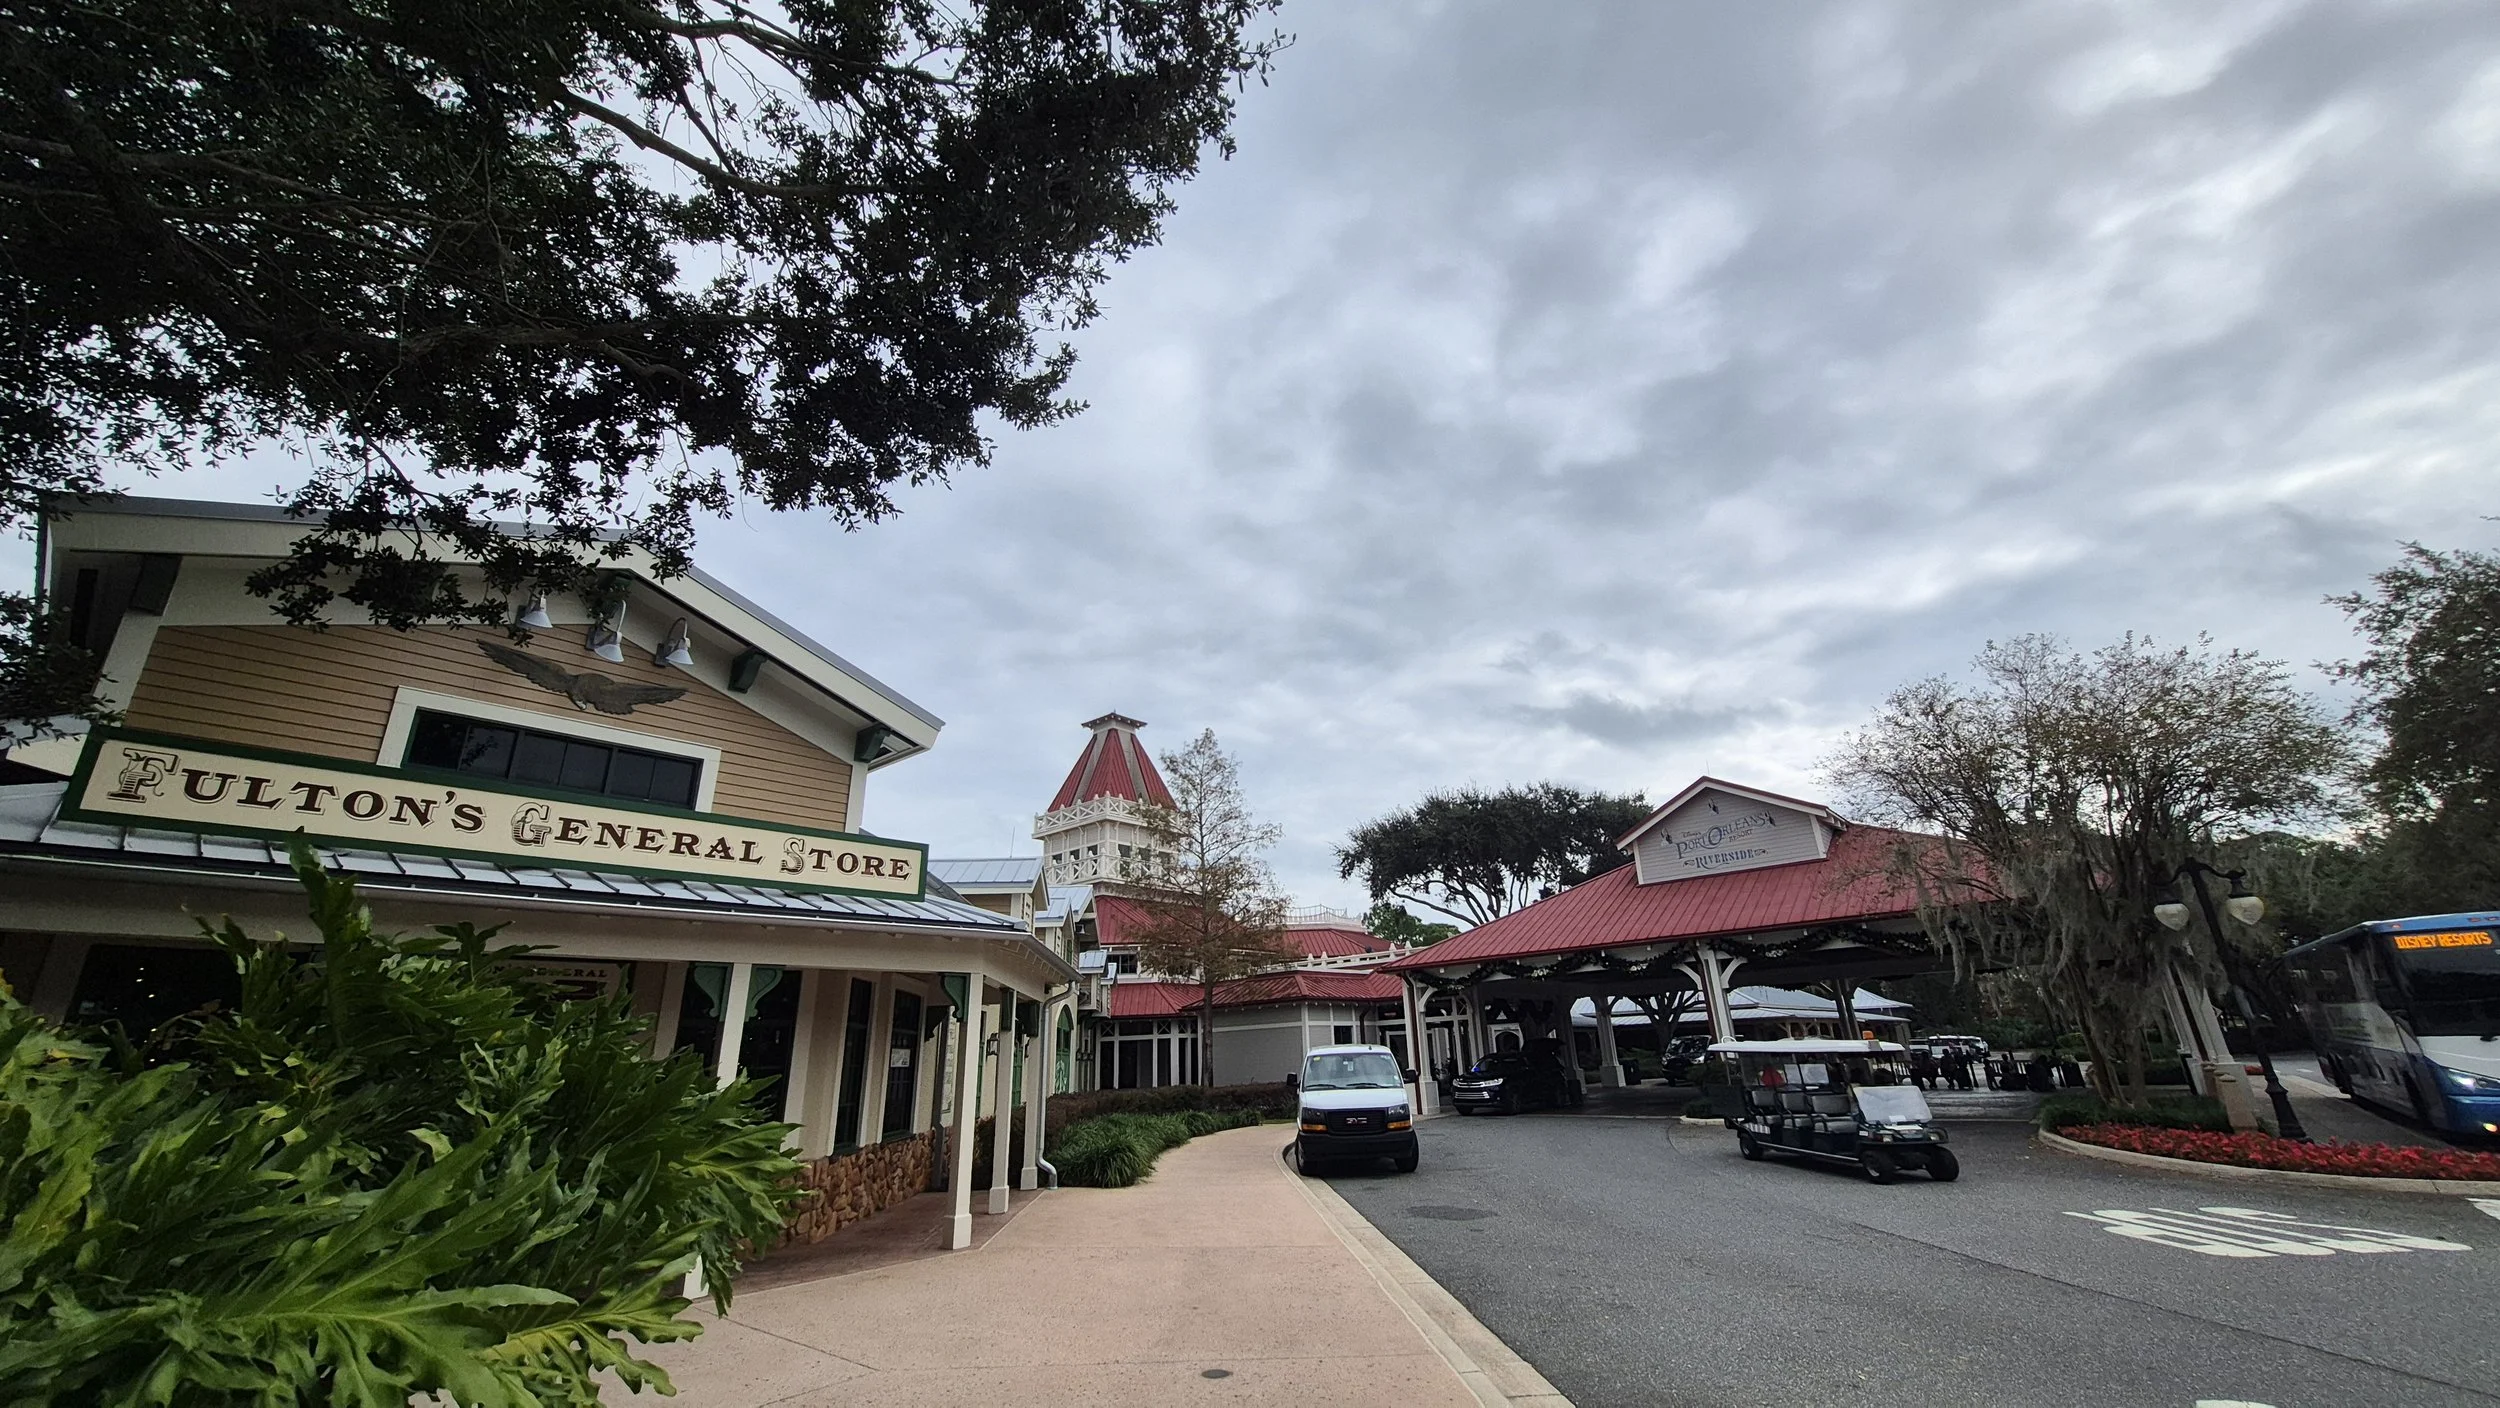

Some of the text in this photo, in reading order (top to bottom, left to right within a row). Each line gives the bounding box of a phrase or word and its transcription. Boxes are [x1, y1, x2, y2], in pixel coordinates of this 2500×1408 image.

[105, 747, 912, 882] FULTON'S GENERAL STORE
[1676, 815, 1766, 860] PORT ORLEANS
[1695, 848, 1755, 869] RIVERSIDE
[2394, 932, 2493, 949] DISNEY RESORTS
[2062, 1206, 2473, 1258] STOP
